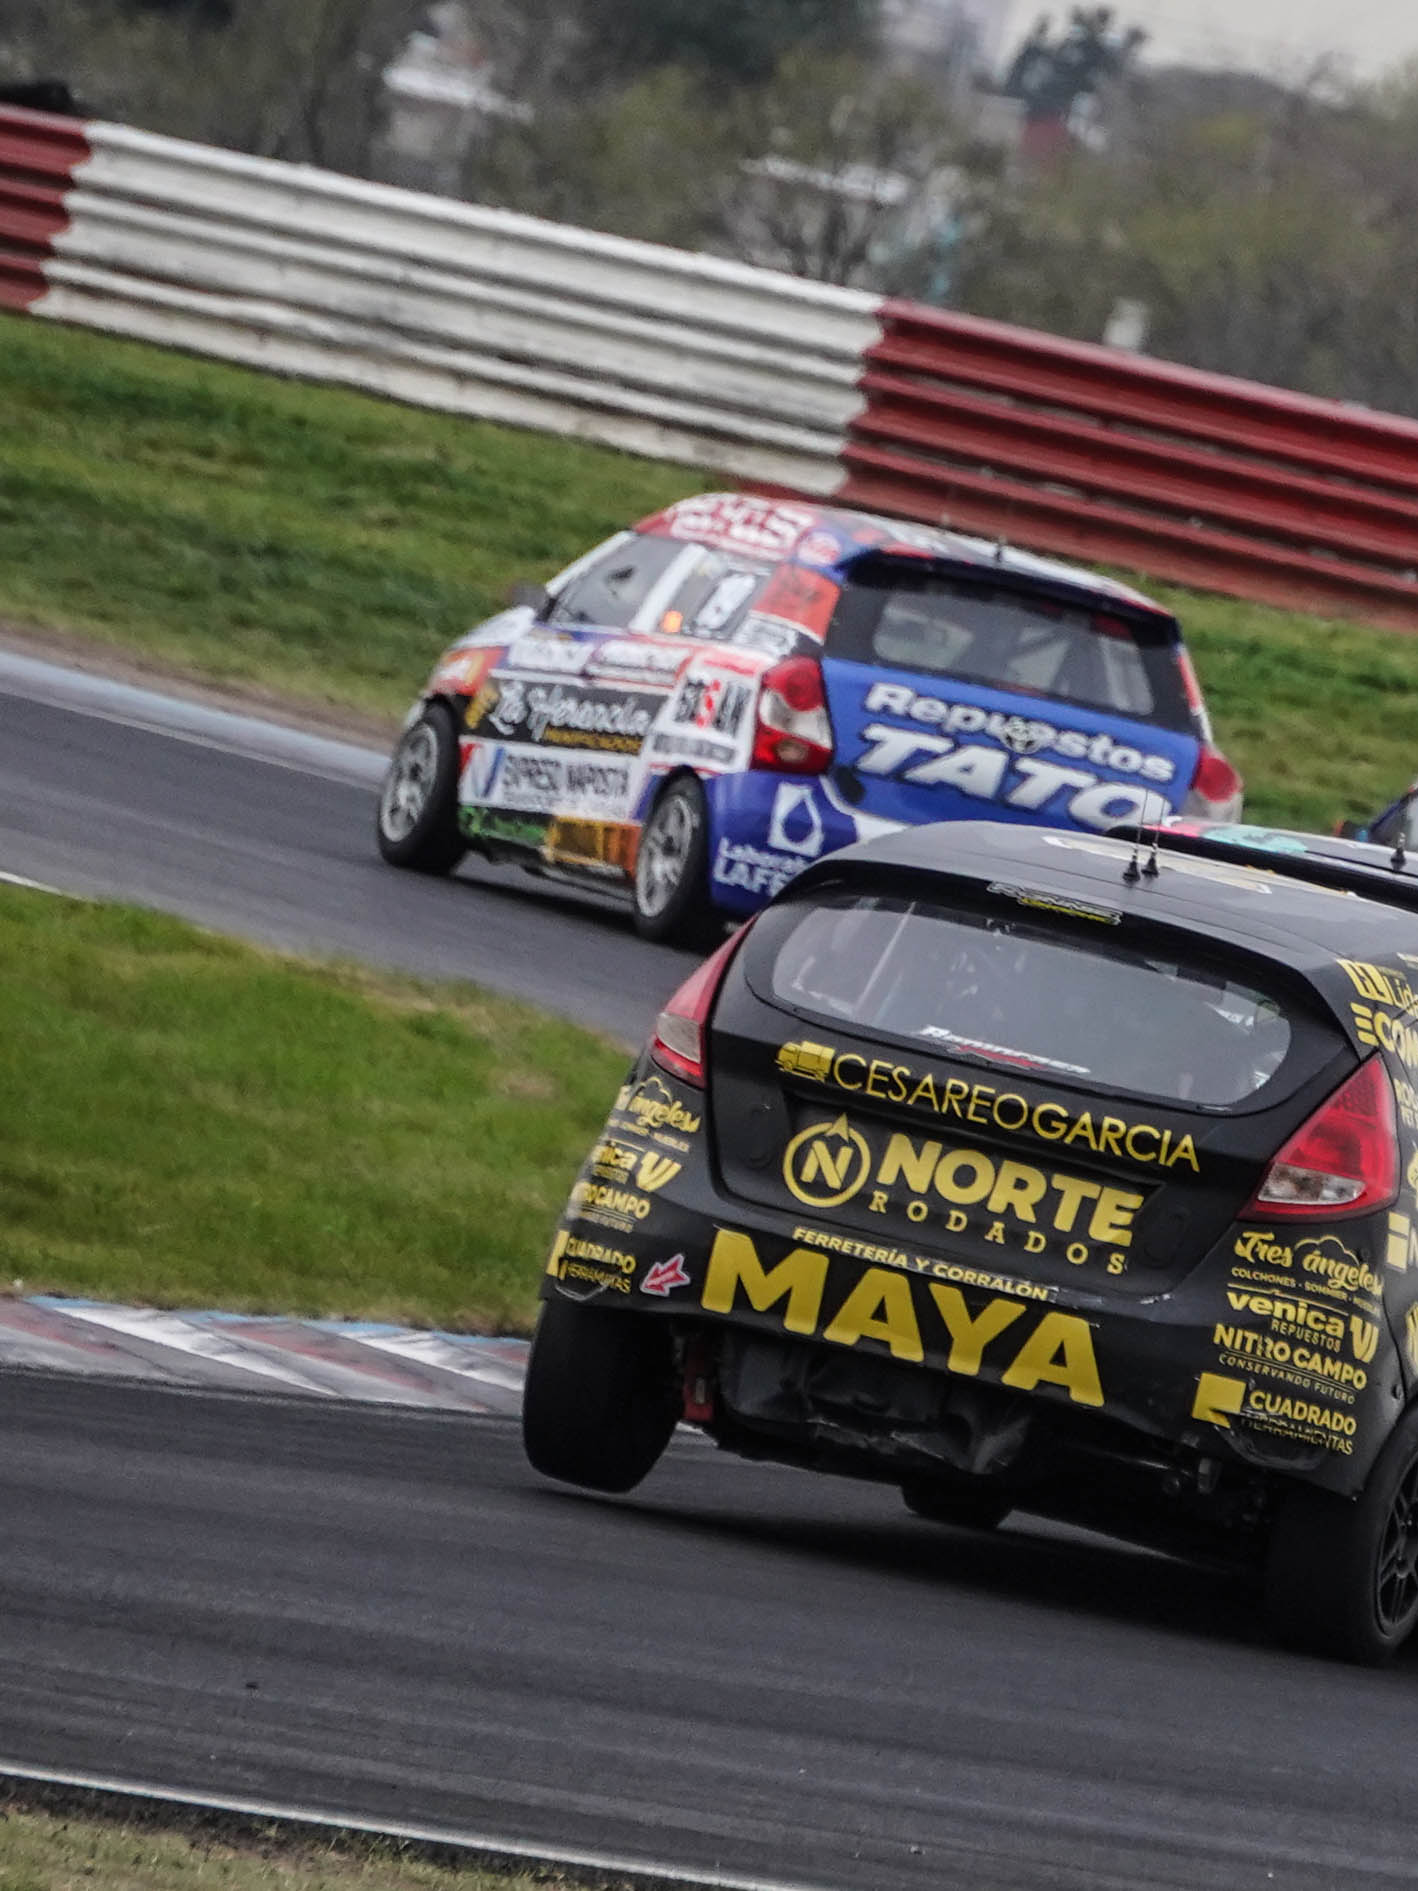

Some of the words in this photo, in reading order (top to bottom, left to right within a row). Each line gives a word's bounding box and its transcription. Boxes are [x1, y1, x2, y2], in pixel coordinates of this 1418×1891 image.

[856, 723, 1172, 829] TATO
[876, 1133, 1145, 1247] NORTE
[792, 1226, 910, 1268] FERRETERÍA
[914, 1258, 931, 1272] Y
[932, 1263, 1049, 1302] CORRALÓN
[868, 1190, 1127, 1277] RODADOS
[1233, 1230, 1294, 1268] Tres
[701, 1229, 1106, 1408] MAYA
[1226, 1291, 1345, 1340] venica
[1270, 1318, 1343, 1354] REPUESTOS
[1217, 1352, 1312, 1389] CONSERVANDO
[1313, 1382, 1357, 1406] FUTURO
[1248, 1390, 1358, 1437] CUADRADO
